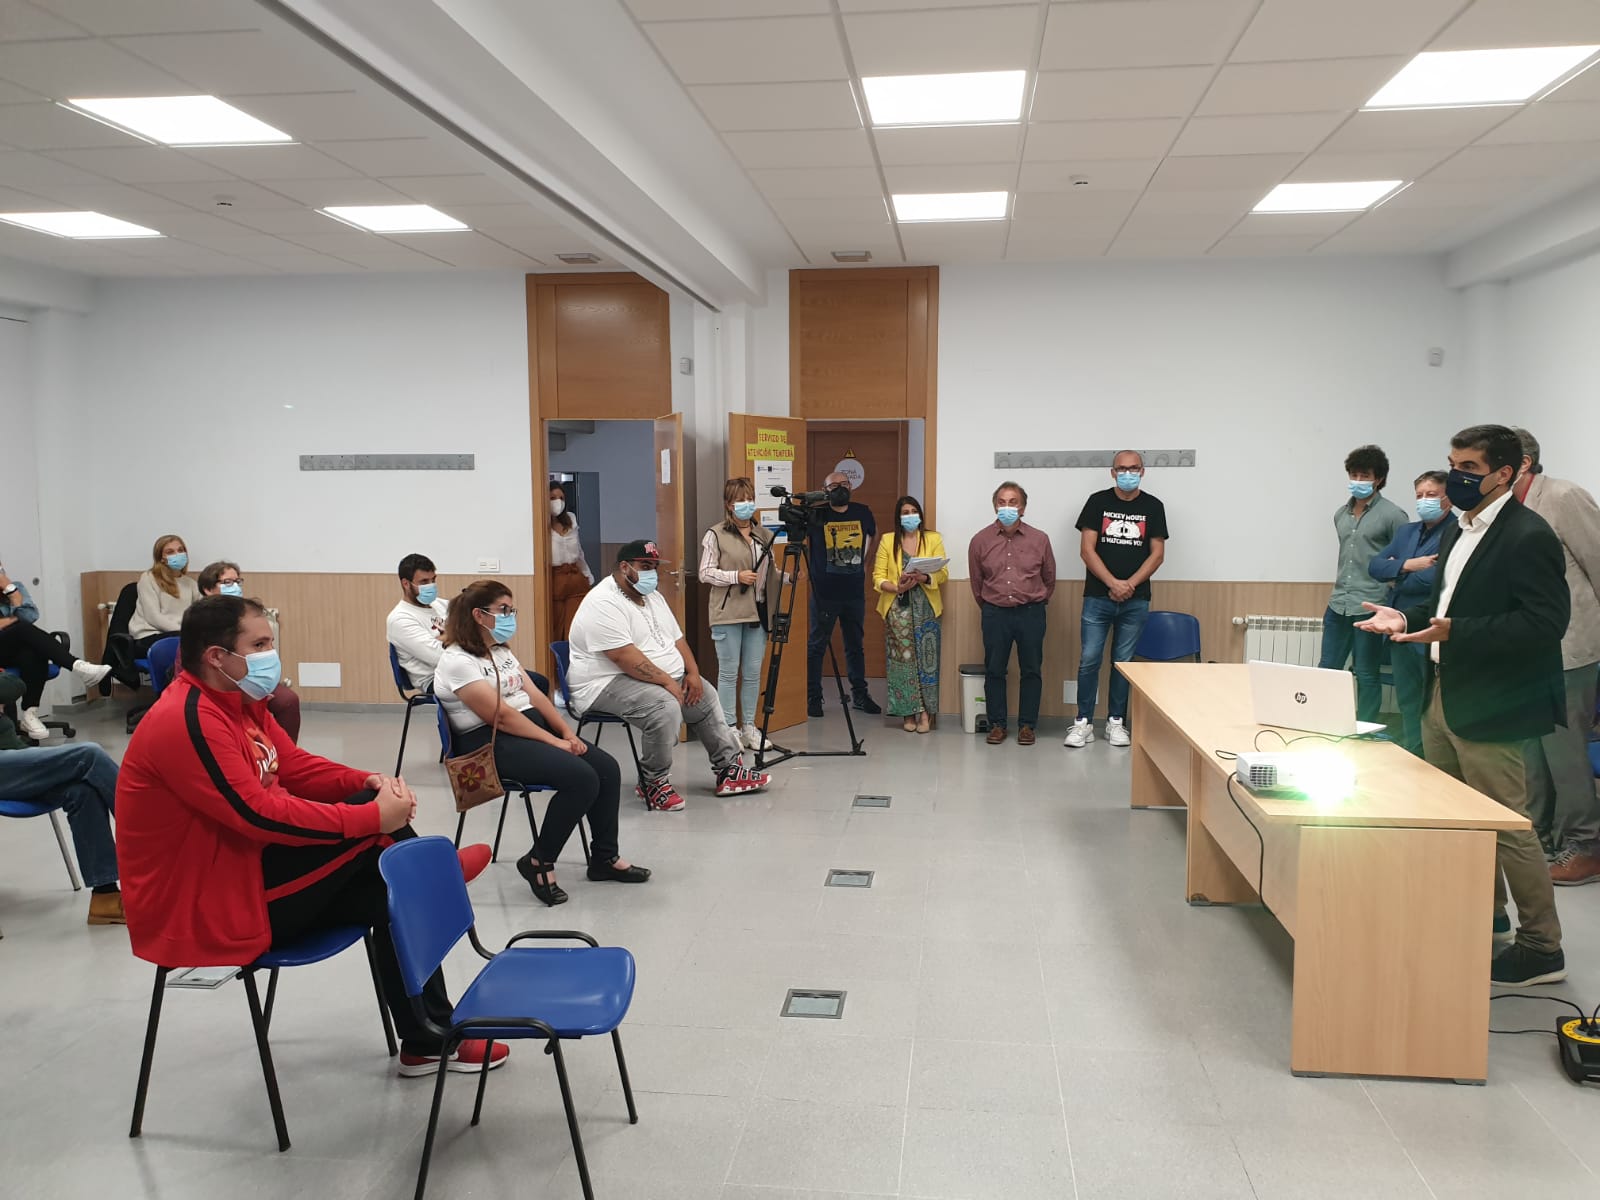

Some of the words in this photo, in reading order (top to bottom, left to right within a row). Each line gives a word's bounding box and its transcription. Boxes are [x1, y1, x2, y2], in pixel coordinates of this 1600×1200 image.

[1103, 511, 1125, 520] MICKEY
[1125, 514, 1147, 522] MOUSE
[1106, 537, 1133, 546] WATCHING
